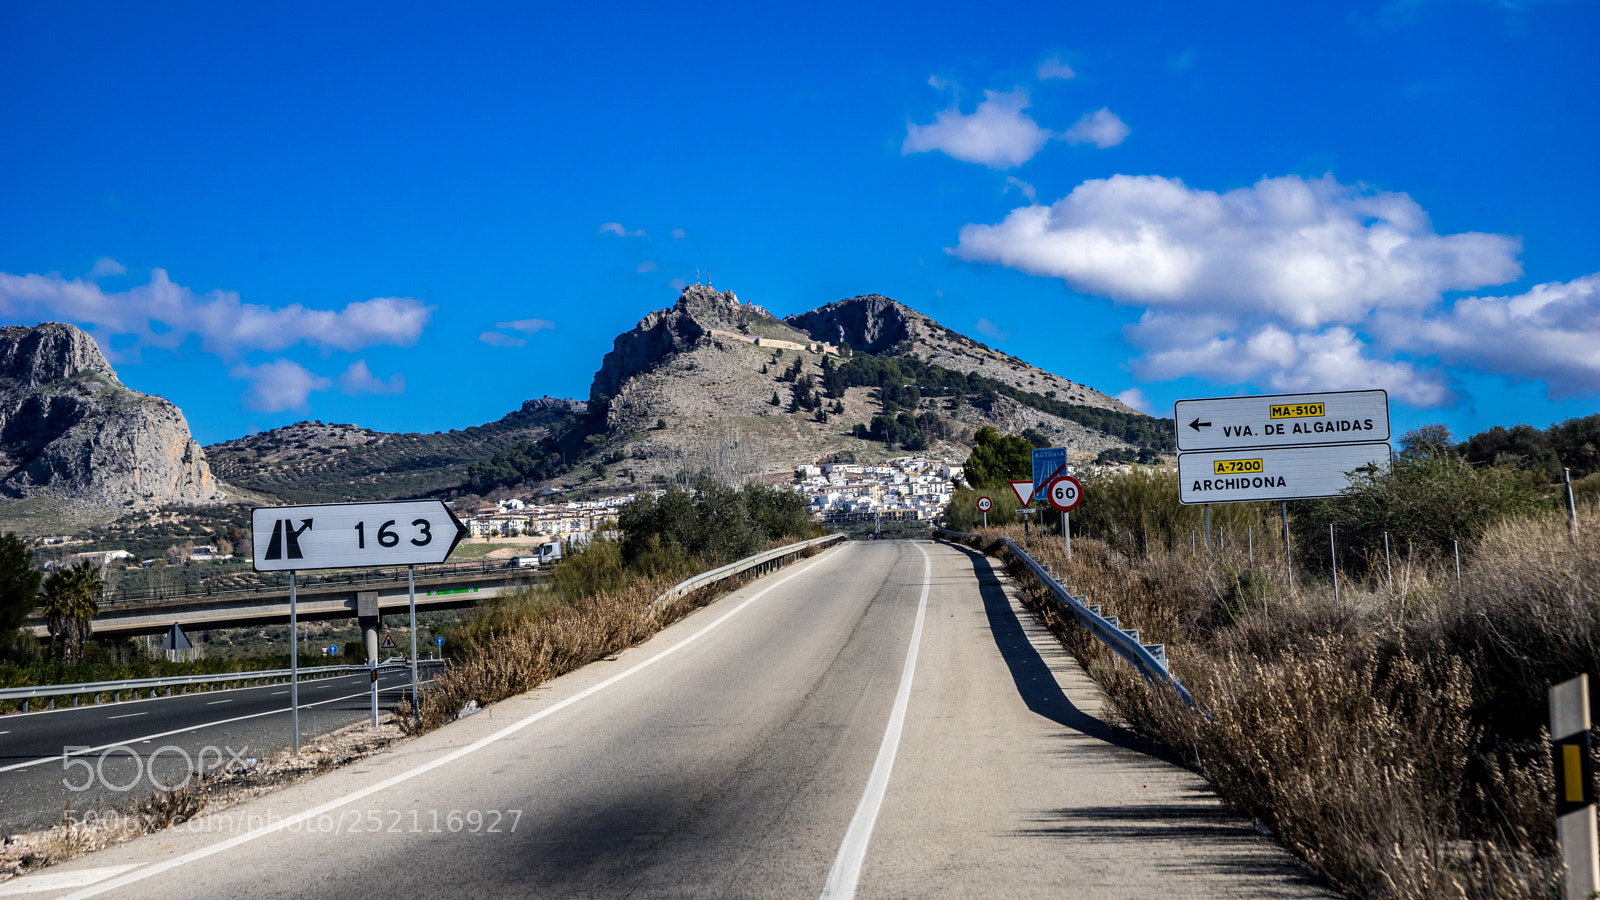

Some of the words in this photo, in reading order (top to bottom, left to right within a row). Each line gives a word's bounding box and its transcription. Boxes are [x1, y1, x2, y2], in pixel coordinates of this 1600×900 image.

[1272, 405, 1323, 417] MA-5101
[1223, 425, 1258, 438] VVA.
[1264, 424, 1285, 435] DE
[1292, 419, 1373, 434] ALGAIDAS
[1217, 461, 1260, 472] A-7200
[1192, 476, 1287, 491] ARCHIDONA
[1055, 487, 1075, 499] 60
[354, 518, 432, 549] 163
